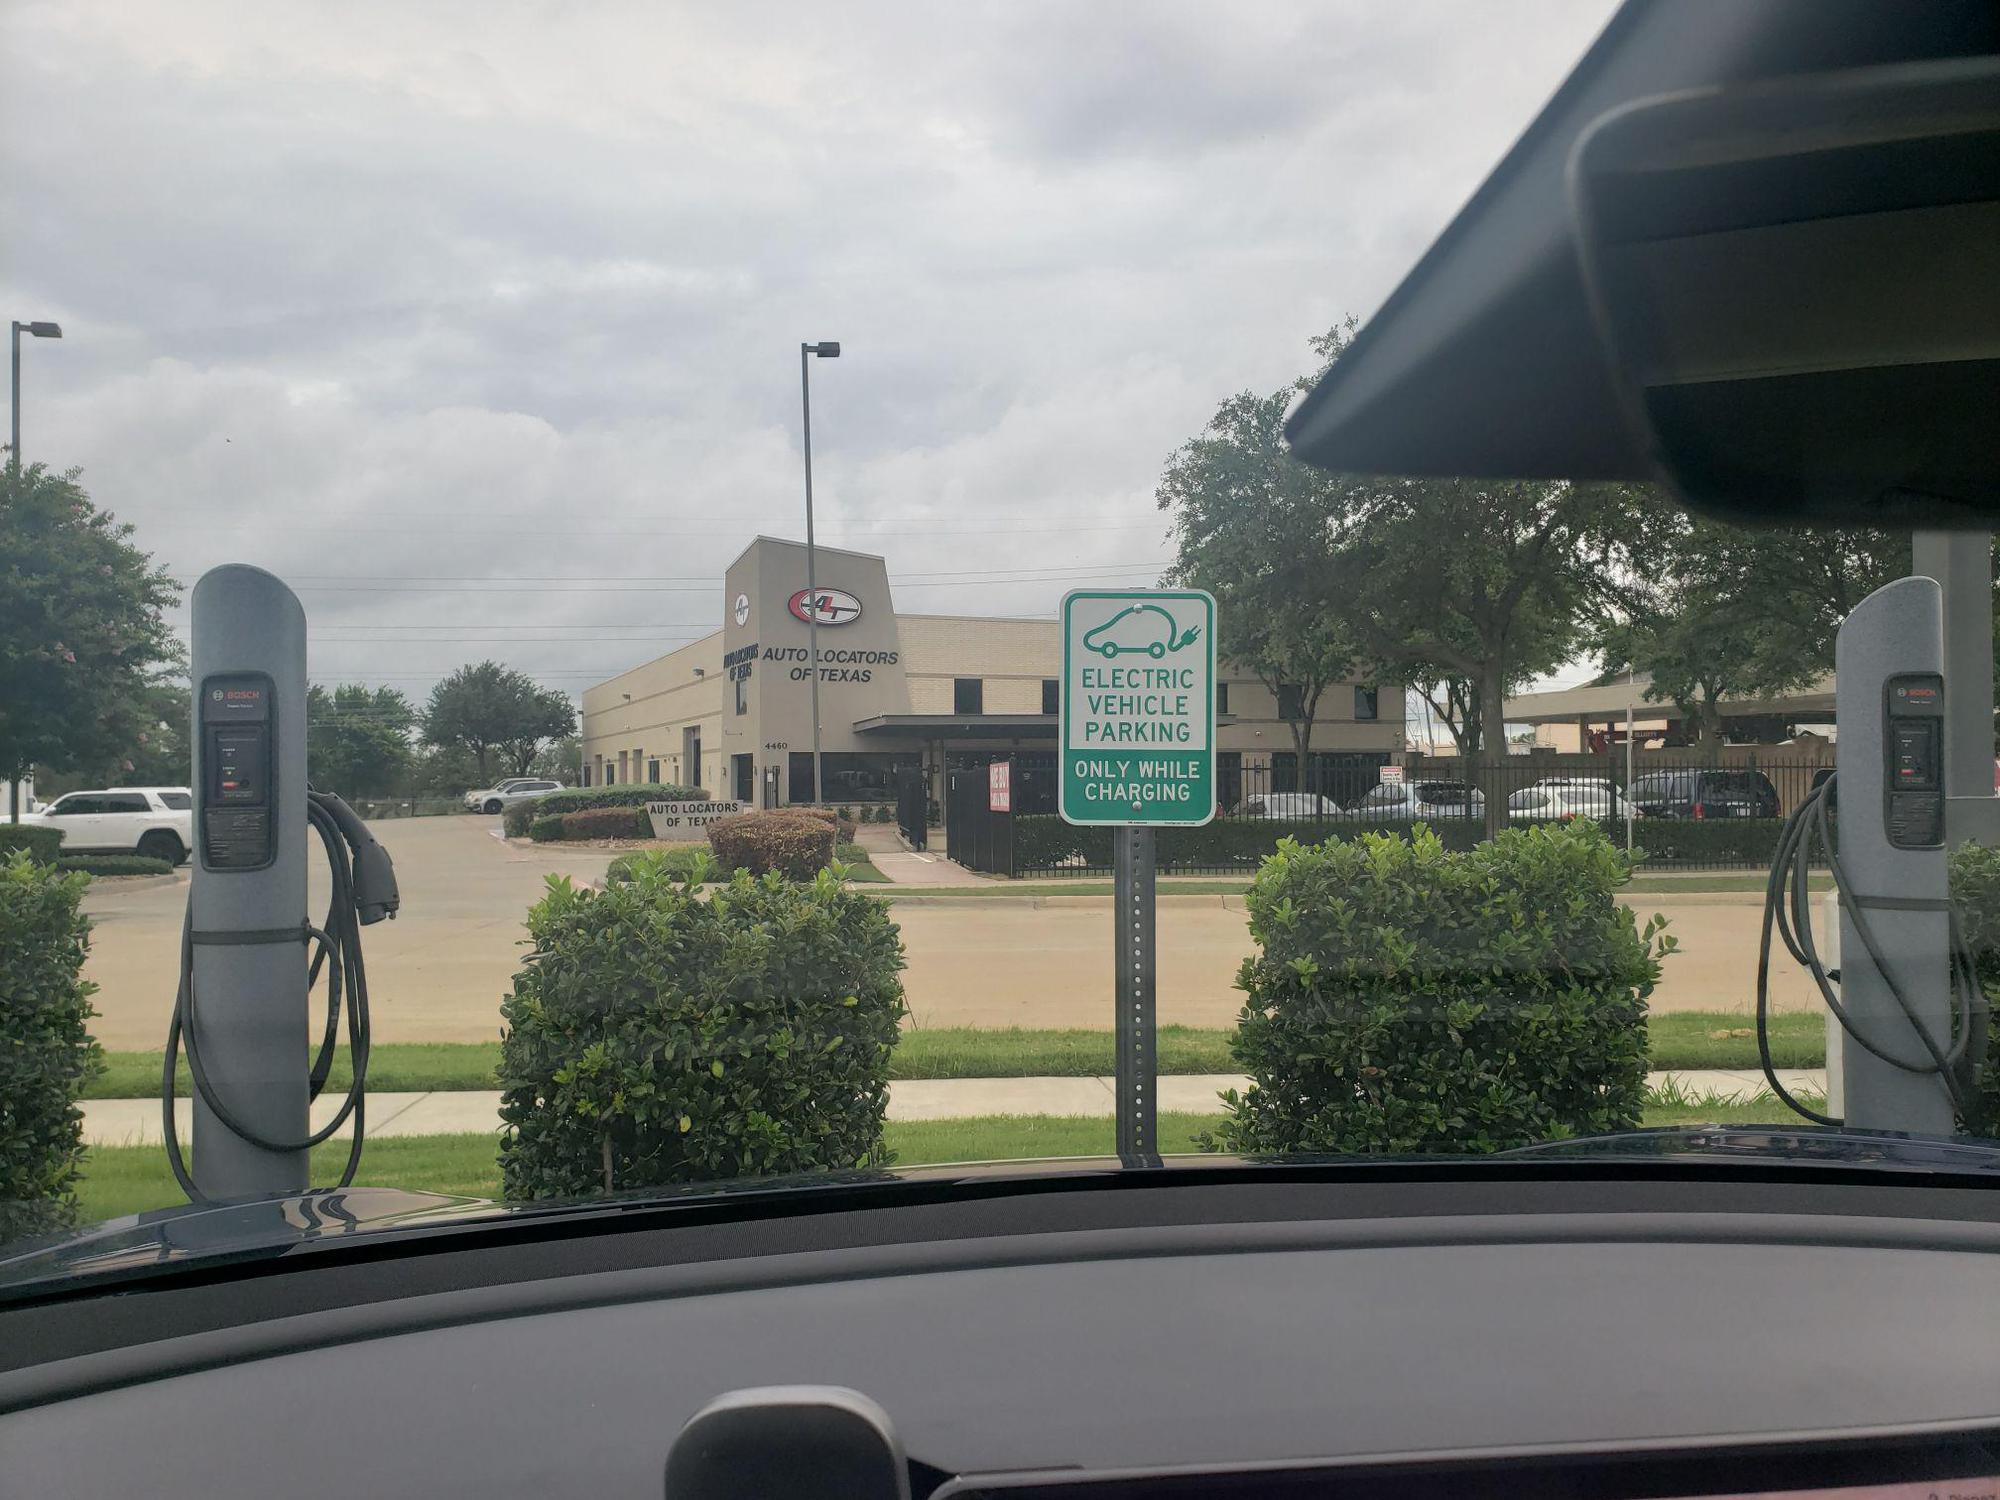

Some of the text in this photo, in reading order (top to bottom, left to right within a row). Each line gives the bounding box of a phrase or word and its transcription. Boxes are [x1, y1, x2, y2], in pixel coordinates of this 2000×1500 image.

[763, 648, 898, 665] AUTO LOCATORS
[790, 667, 872, 683] OF TEXAS
[1082, 668, 1194, 688] ELECTRIC
[226, 691, 260, 700] BOSCH
[1088, 695, 1188, 715] VEHICLE
[1085, 722, 1190, 742] PARKING
[765, 742, 788, 750] 4460
[1075, 760, 1200, 779] ONLY WHILE
[1085, 783, 1190, 801] CHARGING
[650, 803, 738, 814] AUTO LOCATORS
[666, 817, 680, 827] OF
